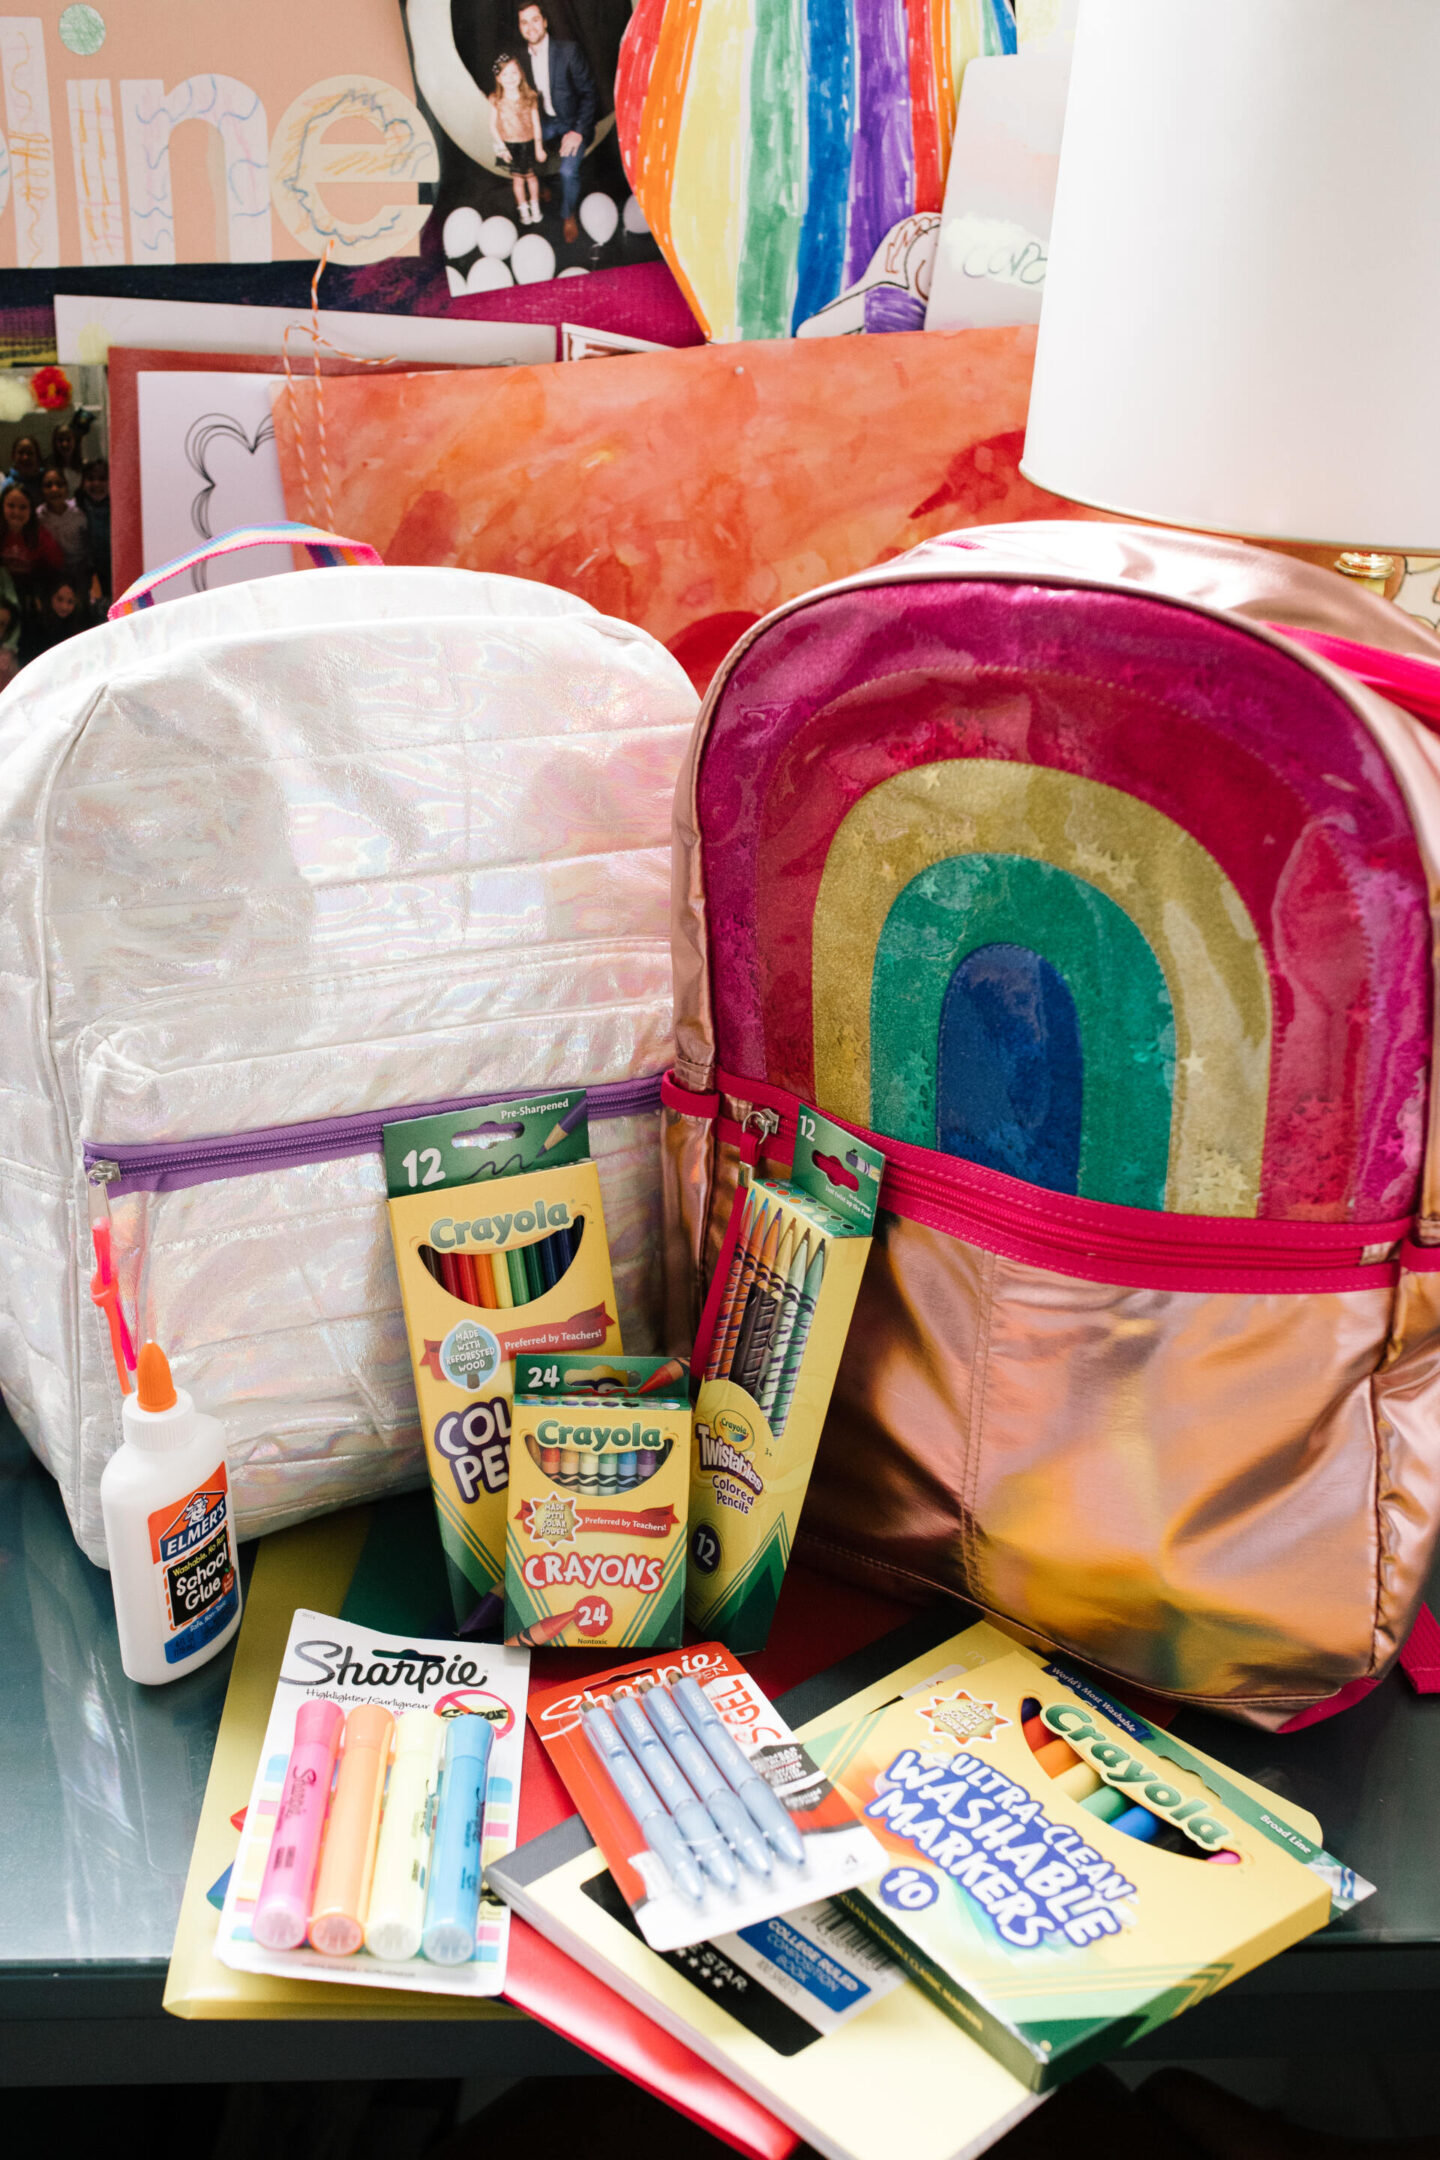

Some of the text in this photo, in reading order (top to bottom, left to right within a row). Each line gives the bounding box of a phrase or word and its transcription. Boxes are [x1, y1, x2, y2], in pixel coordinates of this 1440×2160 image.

[0, 3, 440, 268] line
[501, 1098, 569, 1119] Pre-Sharpened
[800, 1115, 816, 1143] 12
[402, 1148, 446, 1187] 12
[430, 1200, 570, 1249] Crayola
[455, 1329, 480, 1342] MADE
[457, 1340, 481, 1351] WITH
[505, 1329, 602, 1350] Preferred by Teachers!
[446, 1347, 495, 1365] REFORESTED
[458, 1359, 486, 1373] WOOD
[528, 1365, 560, 1388] 24
[538, 1421, 662, 1451] Crayola
[721, 1417, 748, 1435] Crayola
[455, 1444, 510, 1498] PE
[697, 1423, 763, 1494] Twistables
[712, 1475, 754, 1506] Colored
[716, 1490, 749, 1514] Pencils
[166, 1500, 225, 1556] ELMER'S
[542, 1520, 567, 1528] SOLAR
[585, 1516, 667, 1531] Preferred by Teachers!
[695, 1532, 716, 1566] 12
[176, 1543, 227, 1596] School
[525, 1554, 663, 1591] CRAYONS
[185, 1577, 221, 1611] Glue
[577, 1605, 608, 1627] 24
[577, 1638, 608, 1646] Nontoxic
[280, 1640, 487, 1694] Sharpie
[1052, 1666, 1082, 1689] World's
[1081, 1687, 1102, 1704] Most
[1102, 1702, 1136, 1732] Washable
[1046, 1704, 1229, 1845] Crayola
[951, 1754, 1137, 1900] ULTRA-CLEAN
[1260, 1814, 1312, 1855] Broad Line
[888, 1750, 1120, 1945] WASHABLE
[868, 1789, 1055, 1947] MARKERS
[885, 1870, 933, 1908] 10
[701, 1951, 748, 1990] STAR
[768, 1920, 819, 1963] COLLEGE
[818, 1956, 859, 1992] RULED
